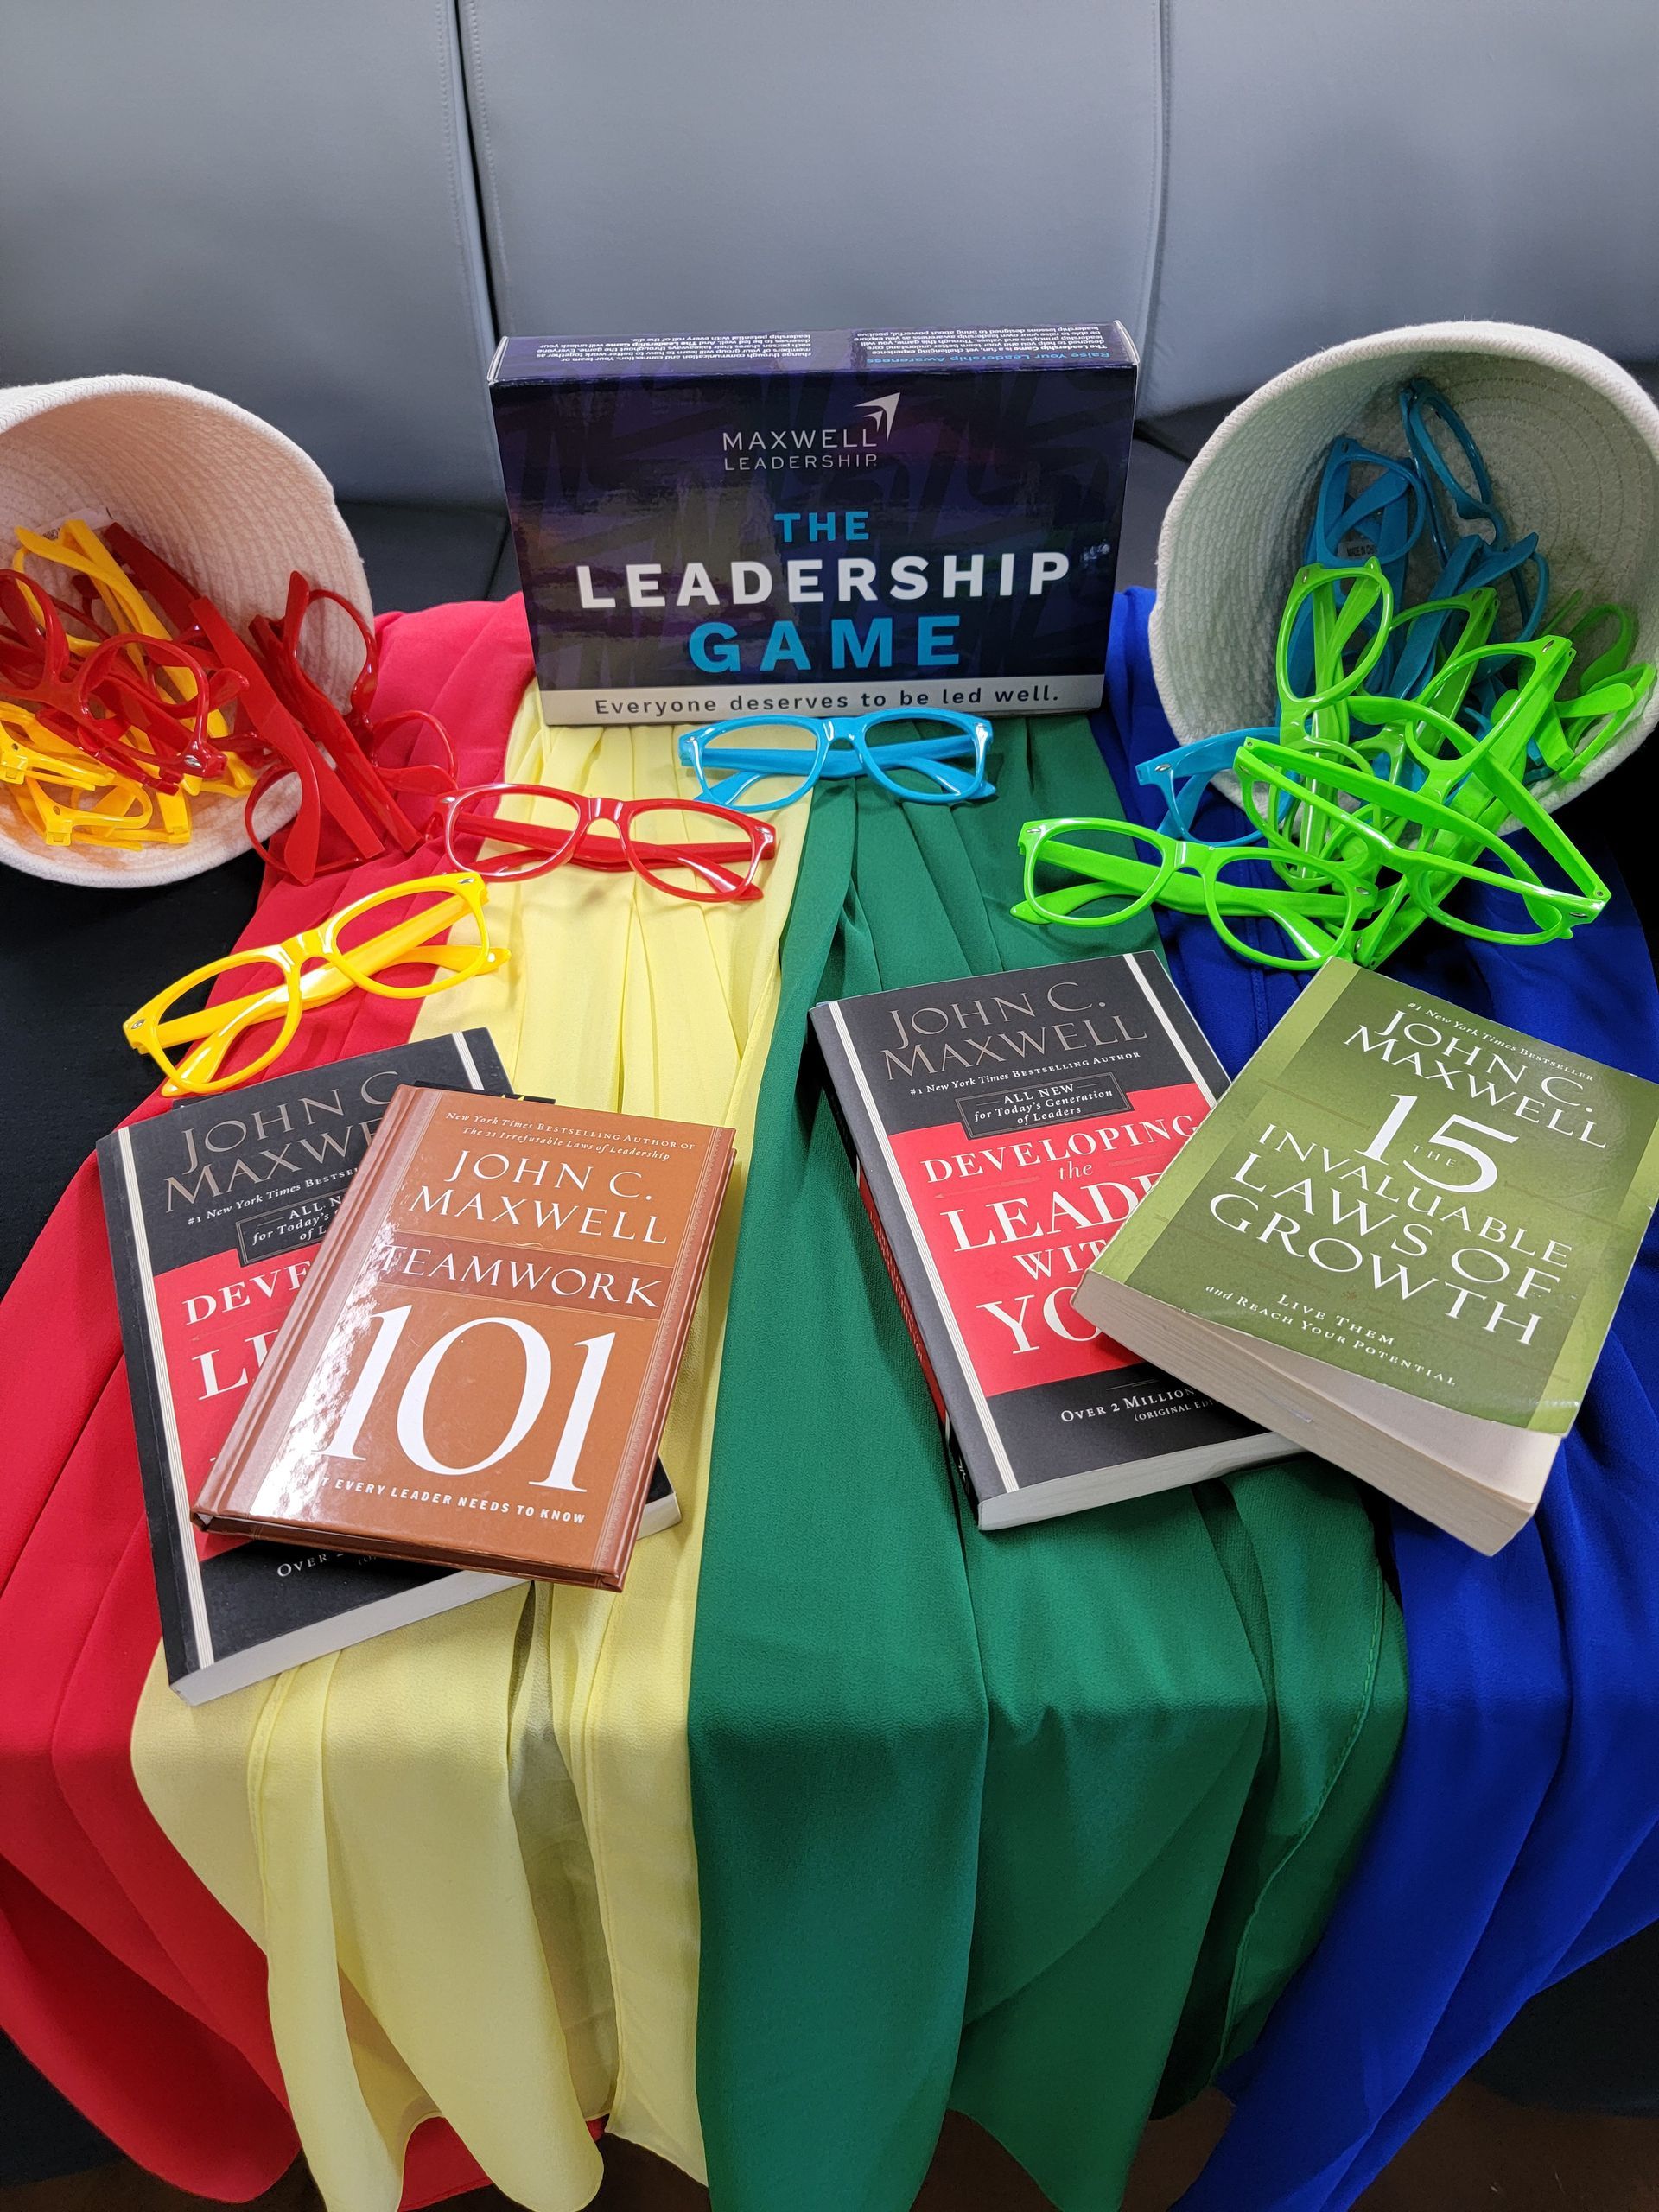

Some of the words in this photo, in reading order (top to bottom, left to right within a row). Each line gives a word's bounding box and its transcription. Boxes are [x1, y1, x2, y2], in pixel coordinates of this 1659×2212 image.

[723, 429, 877, 451] MAXWELL
[724, 454, 877, 471] LEADERSHIP
[774, 511, 869, 543] THE
[576, 551, 1070, 609] LEADERSHIP
[688, 614, 961, 673] GAME
[595, 696, 717, 717] Everyone
[730, 695, 849, 711] deserves
[861, 691, 887, 708] to
[900, 690, 929, 706] be
[943, 689, 982, 705] led
[994, 684, 1059, 702] well.
[890, 993, 1036, 1050] JOHN
[1047, 982, 1106, 1012] C.
[1408, 1002, 1423, 1011] #1
[1425, 1008, 1452, 1024] New
[1453, 1019, 1479, 1037] York
[1481, 1032, 1517, 1052] Times
[1520, 1046, 1594, 1081] BESTSELLER
[880, 1015, 1147, 1080] MAXWELL
[927, 1084, 949, 1093] New
[952, 1077, 976, 1089] York
[978, 1073, 1009, 1084] Times
[1012, 1060, 1090, 1078] BESTSELLING
[1093, 1052, 1141, 1065] AUTHOR
[1374, 1009, 1528, 1084] JOHN
[1541, 1077, 1593, 1113] C.
[974, 1109, 992, 1122] for
[995, 1101, 1041, 1117] Today's
[1045, 1090, 1113, 1108] Generation
[1003, 1091, 1033, 1104] ALL
[1037, 1084, 1075, 1098] NEW
[1343, 1024, 1607, 1148] MAXWELL
[182, 1089, 344, 1175] JOHN
[360, 1071, 398, 1105] C
[445, 1112, 470, 1122] New
[473, 1115, 499, 1125] York
[502, 1118, 533, 1129] Times
[537, 1123, 621, 1141] BESTSELLING
[624, 1134, 677, 1148] AUTHOR
[1017, 1113, 1028, 1125] of
[1033, 1107, 1082, 1122] Leaders
[462, 1127, 483, 1137] The
[499, 1132, 563, 1147] Irrefutable
[566, 1140, 594, 1151] Laws
[596, 1143, 609, 1154] of
[610, 1145, 671, 1161] Leadership
[920, 1115, 1199, 1184] DEVELOPING
[1354, 1094, 1519, 1193] 15
[1413, 1143, 1458, 1168] THE
[187, 1216, 201, 1225] #1
[206, 1205, 232, 1219] New
[236, 1194, 263, 1209] York
[266, 1183, 301, 1199] Times
[305, 1166, 359, 1188] BESTSE
[443, 1149, 594, 1192] JOHN
[609, 1171, 652, 1201] C.
[1058, 1161, 1093, 1180] the
[1257, 1124, 1573, 1268] INVALUABLE
[251, 1230, 273, 1246] for
[277, 1212, 330, 1235] Today's
[289, 1205, 323, 1220] ALL
[299, 1228, 313, 1241] of
[408, 1185, 667, 1244] MAXWELL
[1230, 1151, 1433, 1256] LAWS
[1451, 1248, 1560, 1300] OF
[381, 1243, 663, 1308] TEAMWORK
[1012, 1239, 1107, 1280] WIT
[1209, 1193, 1544, 1346] GROWTH
[976, 1286, 1103, 1355] YO
[1205, 1285, 1234, 1300] and
[1236, 1295, 1294, 1325] REACH
[1301, 1320, 1347, 1344] YOUR
[1353, 1339, 1457, 1387] POTENTIAL
[1277, 1294, 1326, 1320] LIVE
[1336, 1315, 1396, 1346] THEM
[312, 1304, 616, 1493] 101
[1061, 1406, 1106, 1422] OVER
[1111, 1402, 1121, 1412] 2
[1122, 1387, 1196, 1409] MILLION
[1134, 1402, 1192, 1422] (ORIGINAL
[335, 1478, 386, 1496] EVERY
[391, 1485, 452, 1506] LEADER
[458, 1496, 510, 1514] NEEDS
[516, 1505, 535, 1517] TO
[540, 1508, 586, 1524] KNOW
[277, 1554, 328, 1577] OVER
